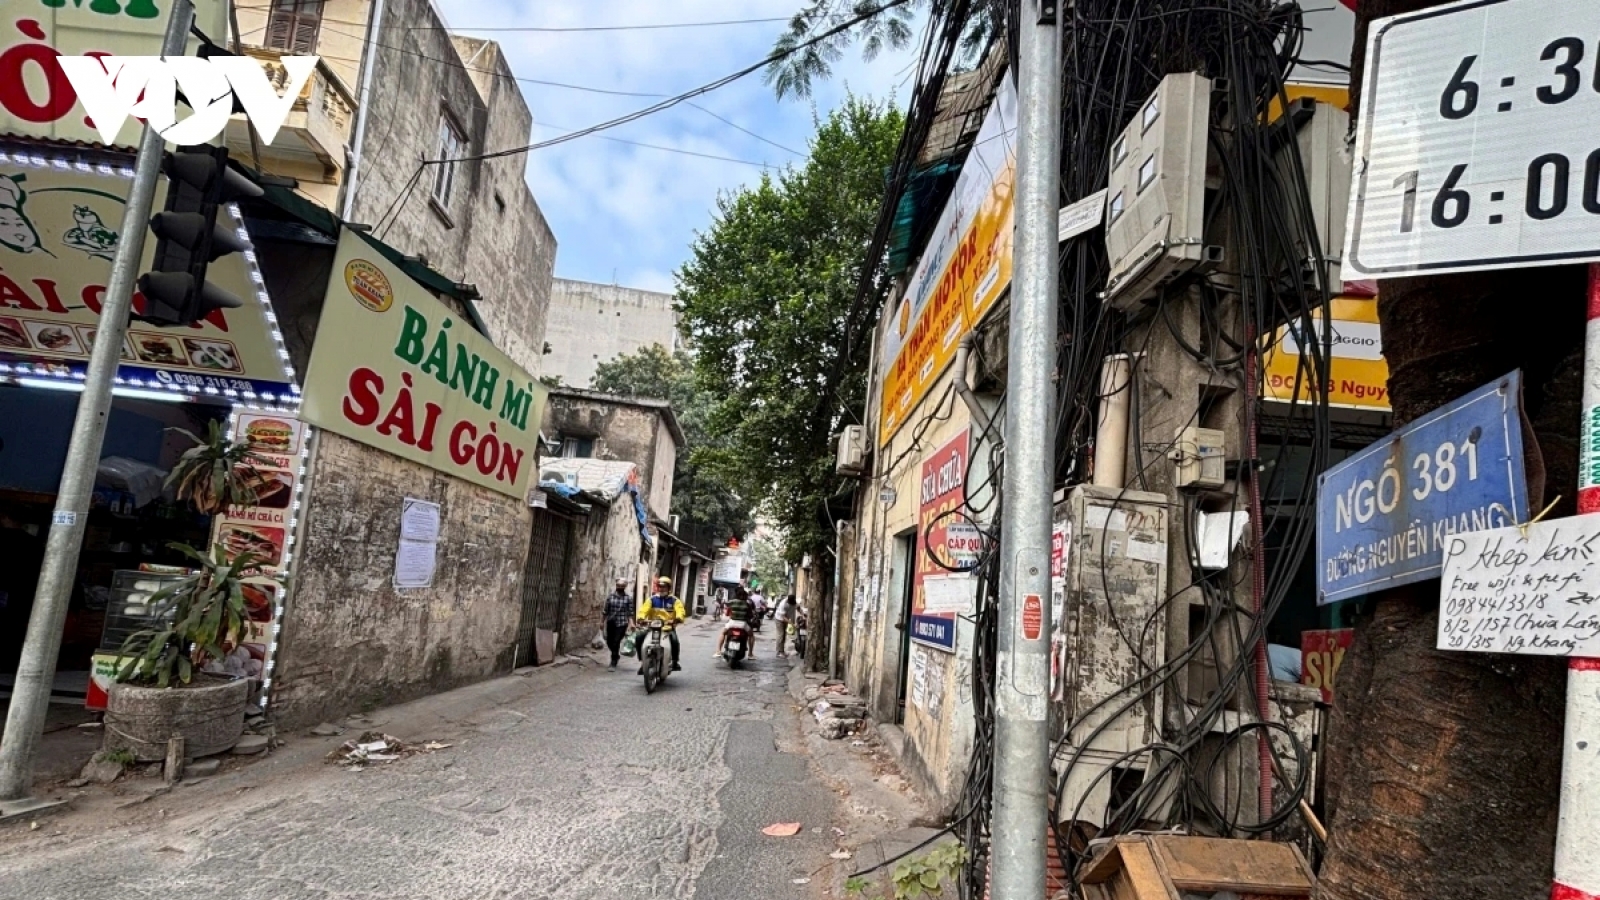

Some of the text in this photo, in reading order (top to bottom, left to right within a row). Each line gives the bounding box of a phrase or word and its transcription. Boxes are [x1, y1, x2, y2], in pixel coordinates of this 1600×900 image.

[1440, 36, 1600, 120] 6:3
[934, 224, 977, 324] MOTOR
[394, 305, 533, 431] BÁNH MÌ
[343, 367, 524, 486] SÀI GÒN
[1412, 437, 1477, 501] 381
